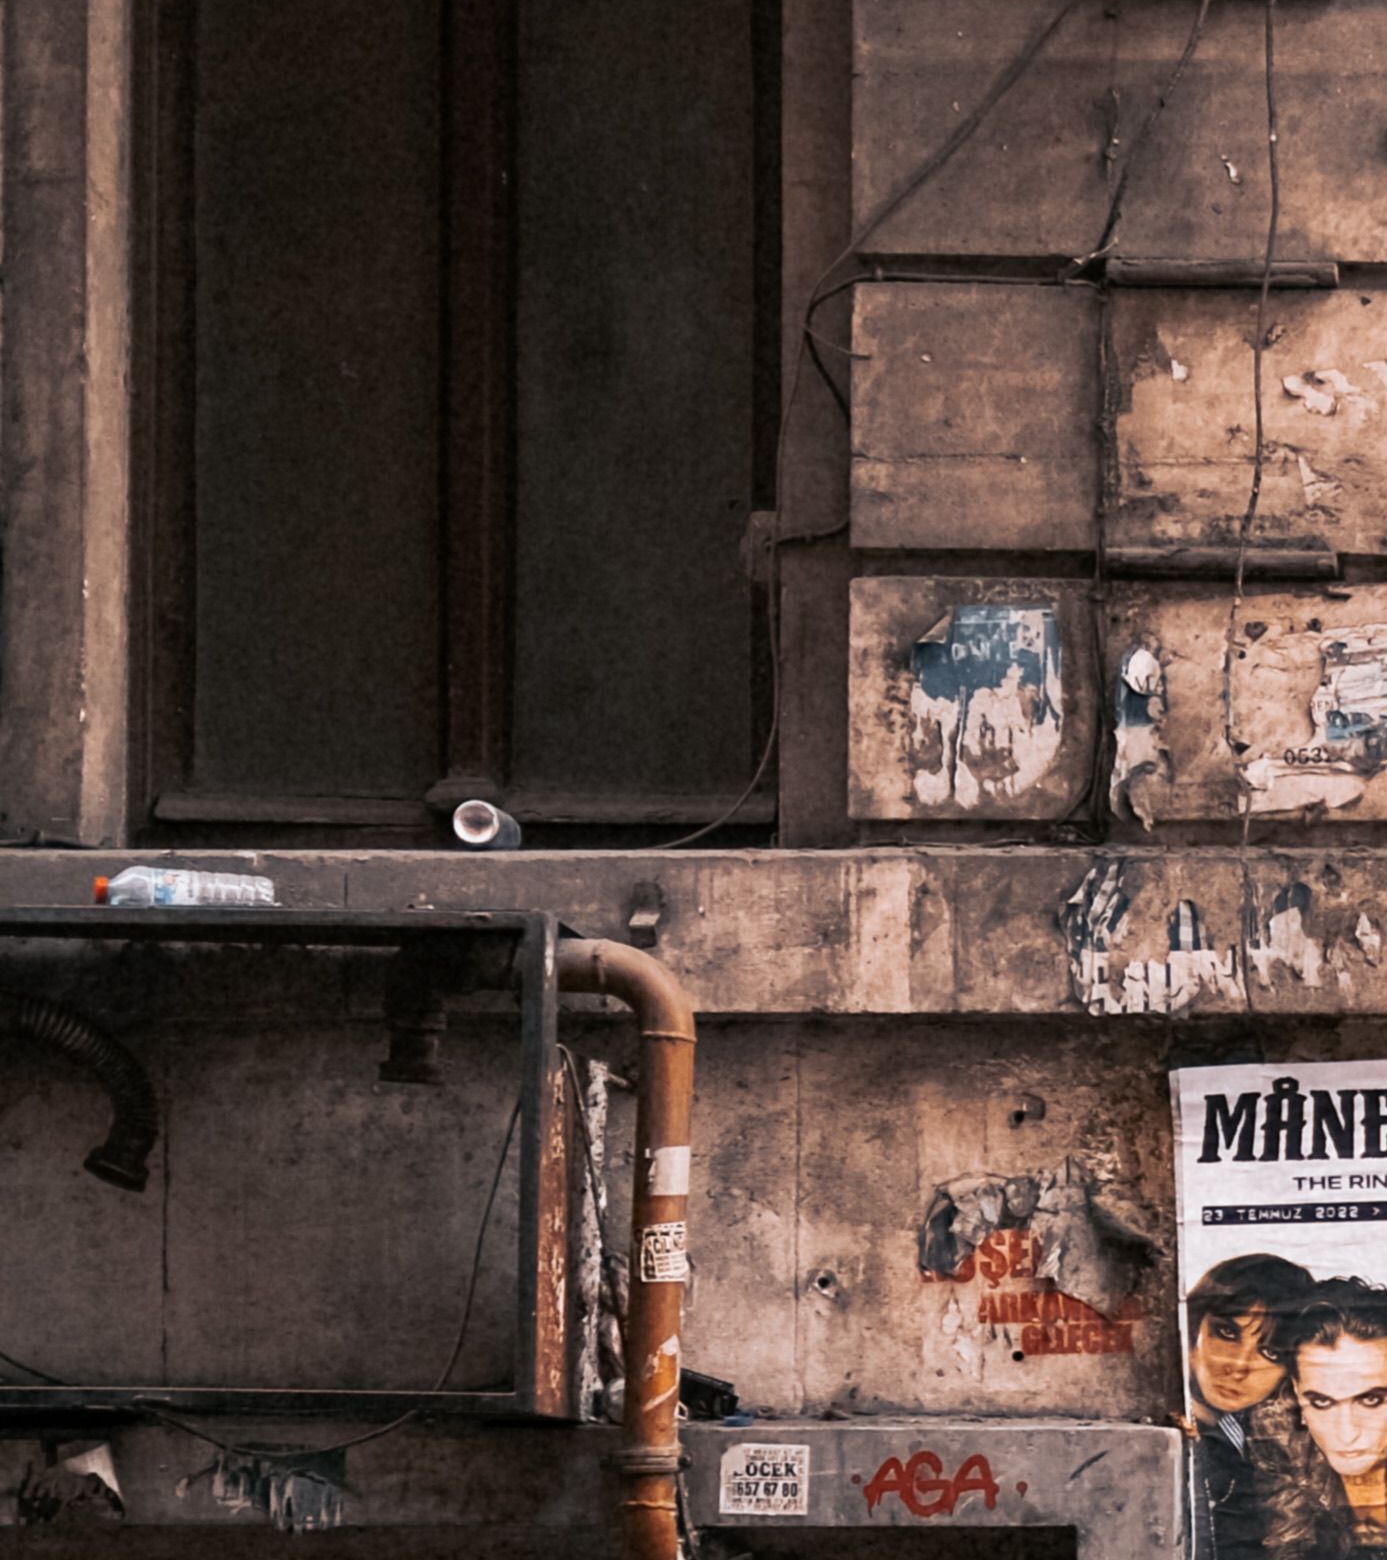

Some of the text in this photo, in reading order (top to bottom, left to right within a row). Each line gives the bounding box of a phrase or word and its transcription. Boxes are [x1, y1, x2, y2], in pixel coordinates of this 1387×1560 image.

[1293, 1175, 1343, 1191] THE
[1202, 1209, 1224, 1222] 23
[1236, 1207, 1301, 1220] TEMMUZ
[1315, 1205, 1360, 1218] 2022
